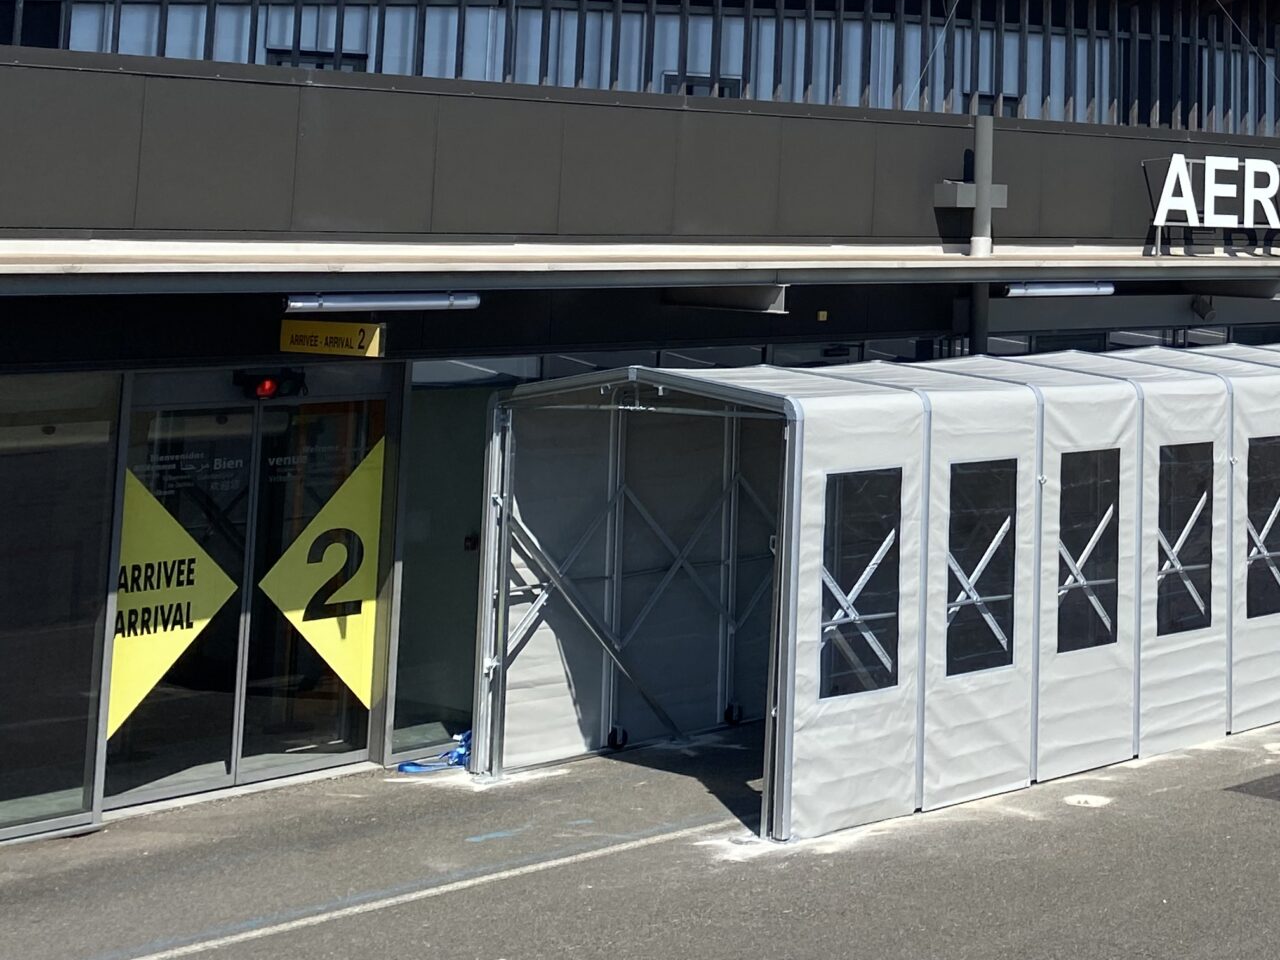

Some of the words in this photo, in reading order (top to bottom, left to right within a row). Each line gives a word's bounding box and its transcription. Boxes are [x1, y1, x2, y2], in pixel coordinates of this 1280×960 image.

[324, 336, 354, 349] ARRIVAL
[358, 328, 366, 350] 2
[213, 458, 243, 470] Bien
[117, 557, 196, 593] ARRIVEE
[302, 528, 364, 622] 2
[114, 601, 193, 639] ARRIVAL
